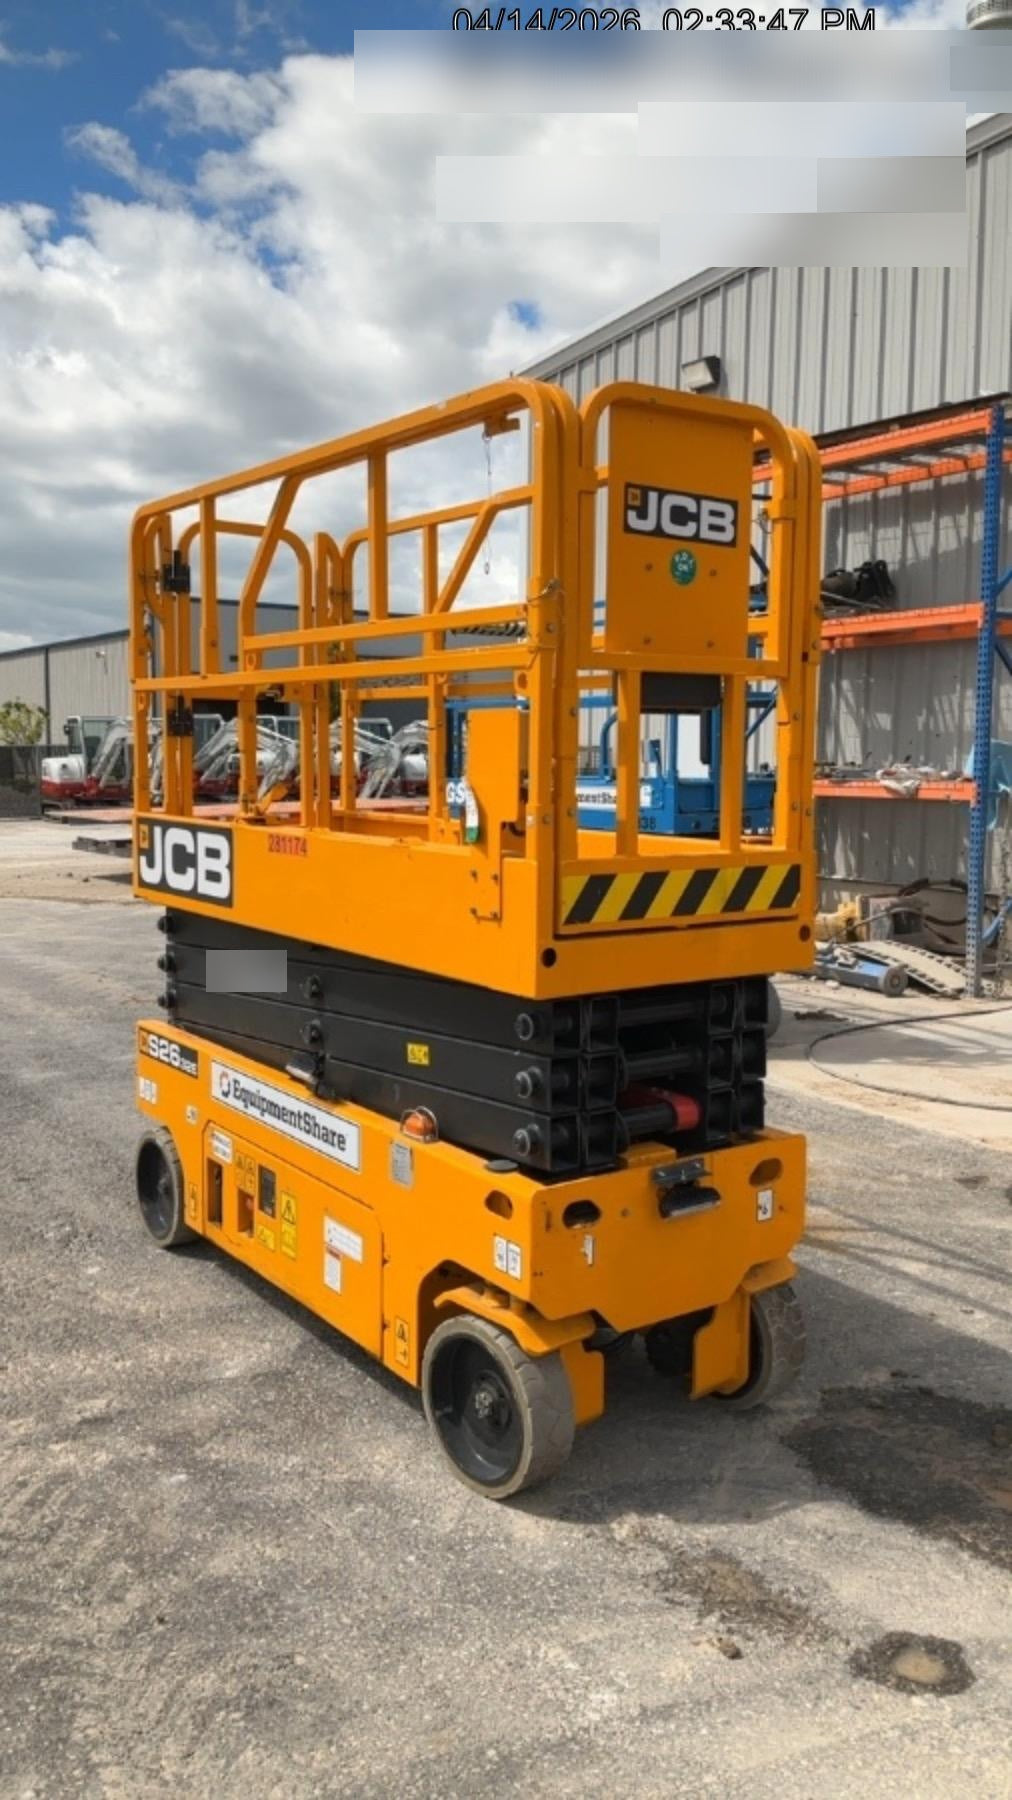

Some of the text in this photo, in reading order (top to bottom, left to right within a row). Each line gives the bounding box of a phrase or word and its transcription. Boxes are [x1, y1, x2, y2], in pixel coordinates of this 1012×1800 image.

[627, 491, 735, 543] JCB
[139, 825, 231, 899] JCB
[232, 1079, 347, 1152] EquipmentShare
